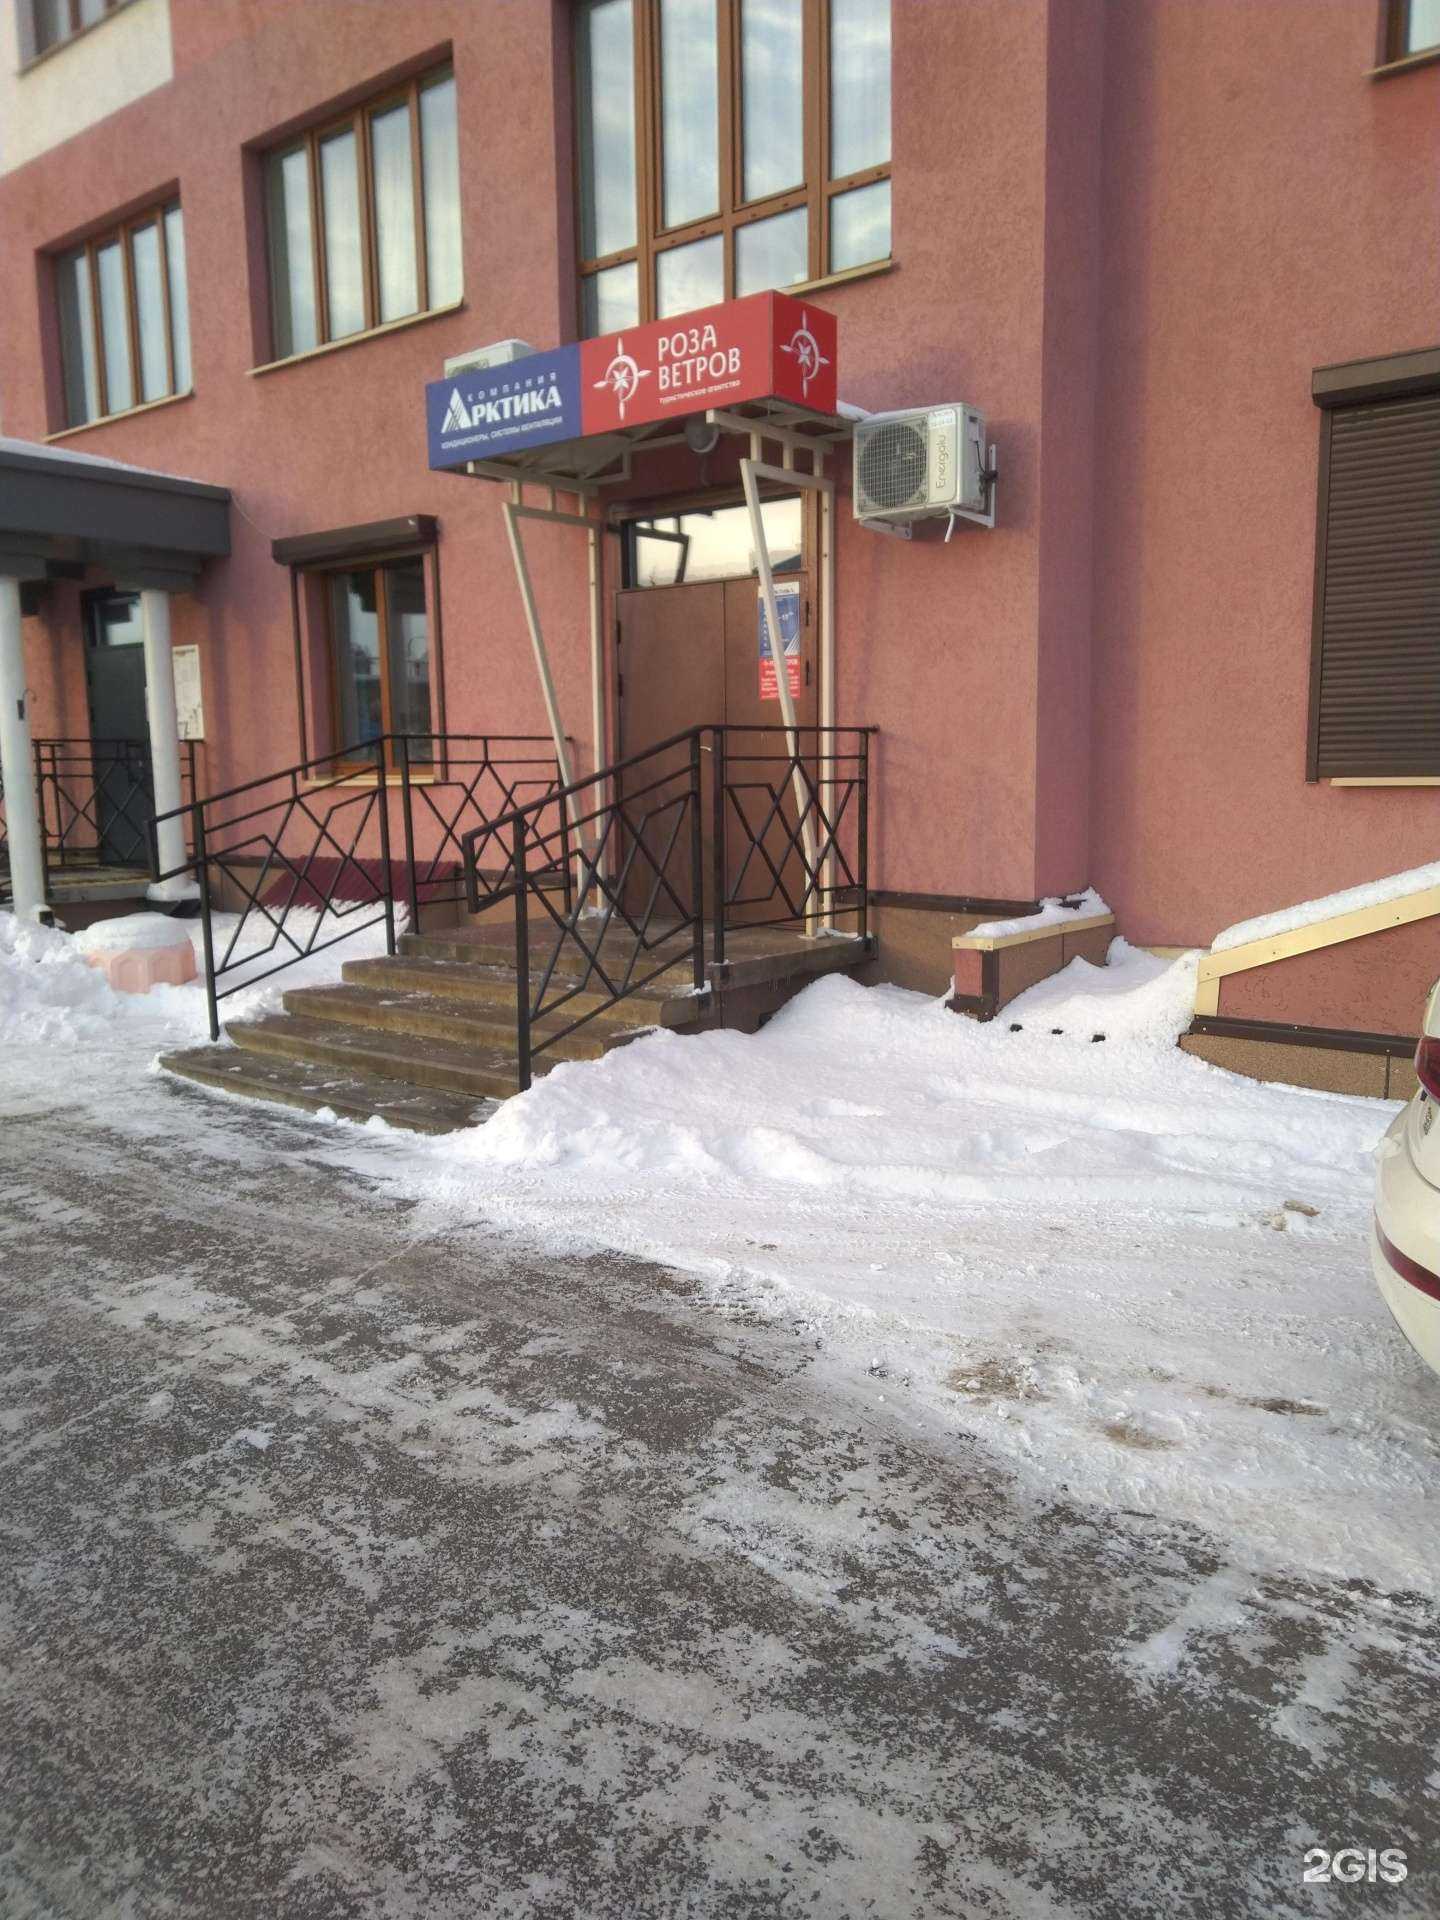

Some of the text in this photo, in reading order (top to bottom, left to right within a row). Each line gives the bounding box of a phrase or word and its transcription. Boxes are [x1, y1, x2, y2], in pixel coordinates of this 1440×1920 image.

[658, 324, 717, 361] РОЗА
[467, 372, 556, 402] КОМПАНИЯ
[658, 347, 741, 390] ВЕТРОВ
[441, 386, 562, 434] АРКТИКА
